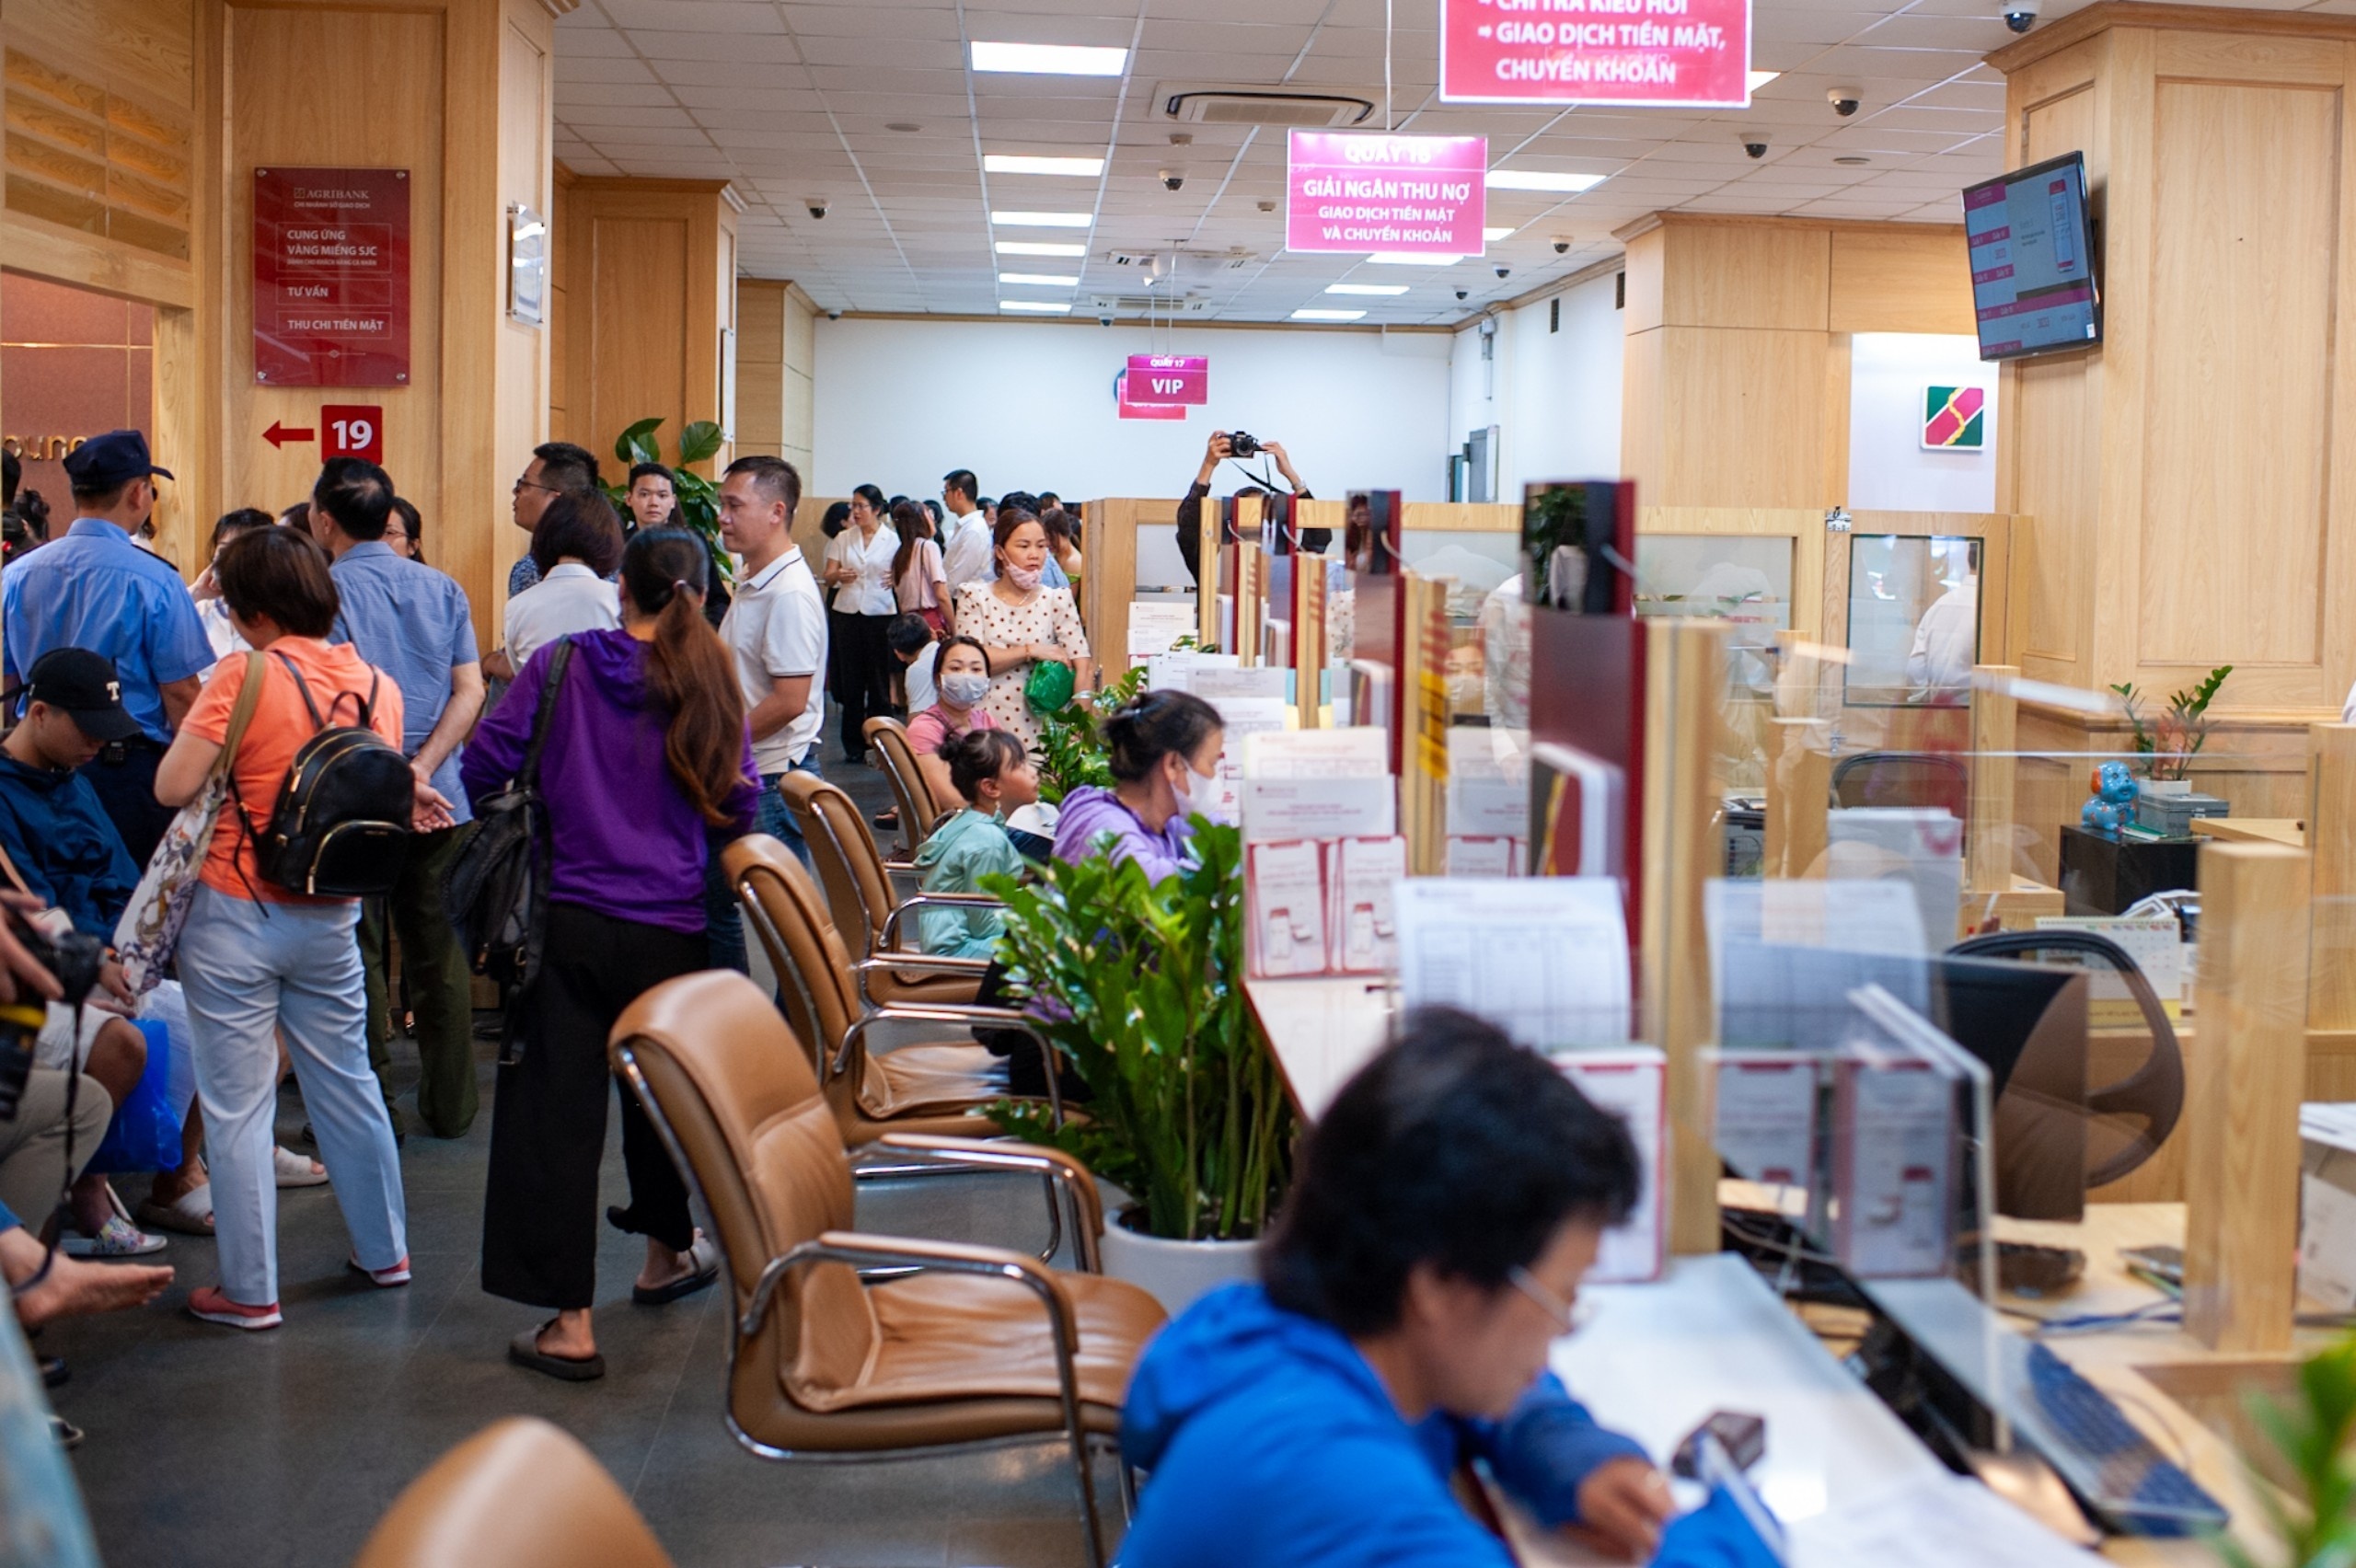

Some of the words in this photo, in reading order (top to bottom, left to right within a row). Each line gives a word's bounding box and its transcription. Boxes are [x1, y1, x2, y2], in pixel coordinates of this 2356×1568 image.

[1496, 21, 1554, 44] GIAO
[1559, 23, 1615, 49] DỊCH
[1672, 23, 1727, 52] MẶT,
[306, 189, 370, 199] AGRIBANK
[1303, 175, 1341, 197] GIẢI
[1345, 179, 1398, 200] NGÂN
[1401, 182, 1438, 201] THU
[1442, 183, 1470, 205] NỢ
[1319, 205, 1353, 219] GIAO
[1356, 207, 1389, 223] DỊCH
[1425, 207, 1455, 225] MẶT
[286, 229, 318, 240] CUNG
[320, 227, 346, 240] ỨNG
[1322, 225, 1341, 240] VÀ
[286, 243, 318, 255] VÀNG
[287, 285, 304, 296] TƯ
[287, 319, 310, 330] THU
[312, 319, 331, 330] CHI
[359, 318, 385, 333] MẶT
[1150, 377, 1184, 395] VIP
[331, 419, 373, 450] 19
[106, 681, 120, 701] T
